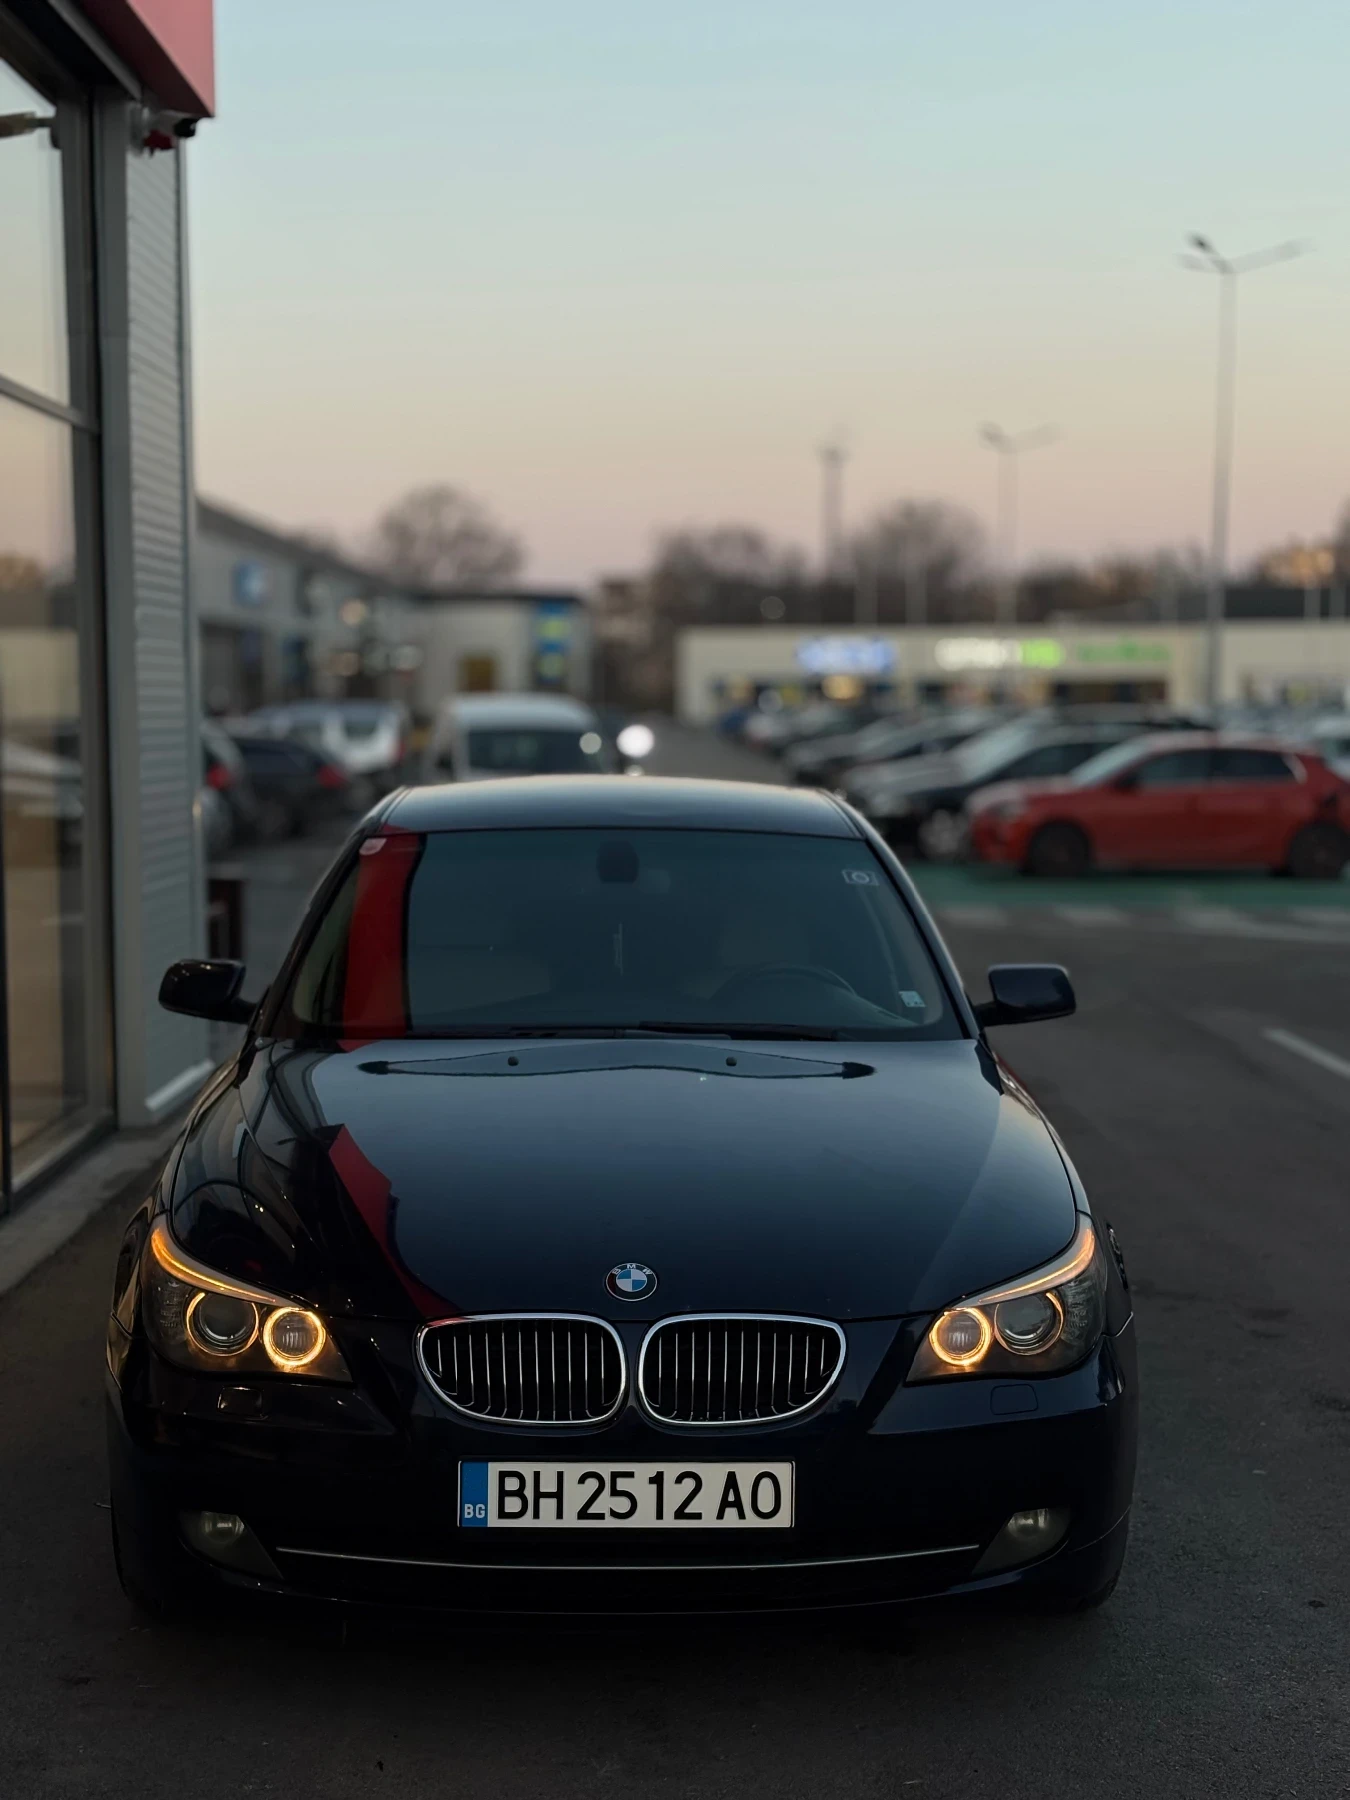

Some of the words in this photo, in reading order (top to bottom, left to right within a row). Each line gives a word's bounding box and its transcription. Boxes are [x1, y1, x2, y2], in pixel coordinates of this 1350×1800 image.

[611, 1263, 653, 1275] BMW
[497, 1471, 564, 1520] BH
[576, 1471, 703, 1520] 2512
[716, 1471, 782, 1520] AO
[464, 1504, 486, 1518] BG
